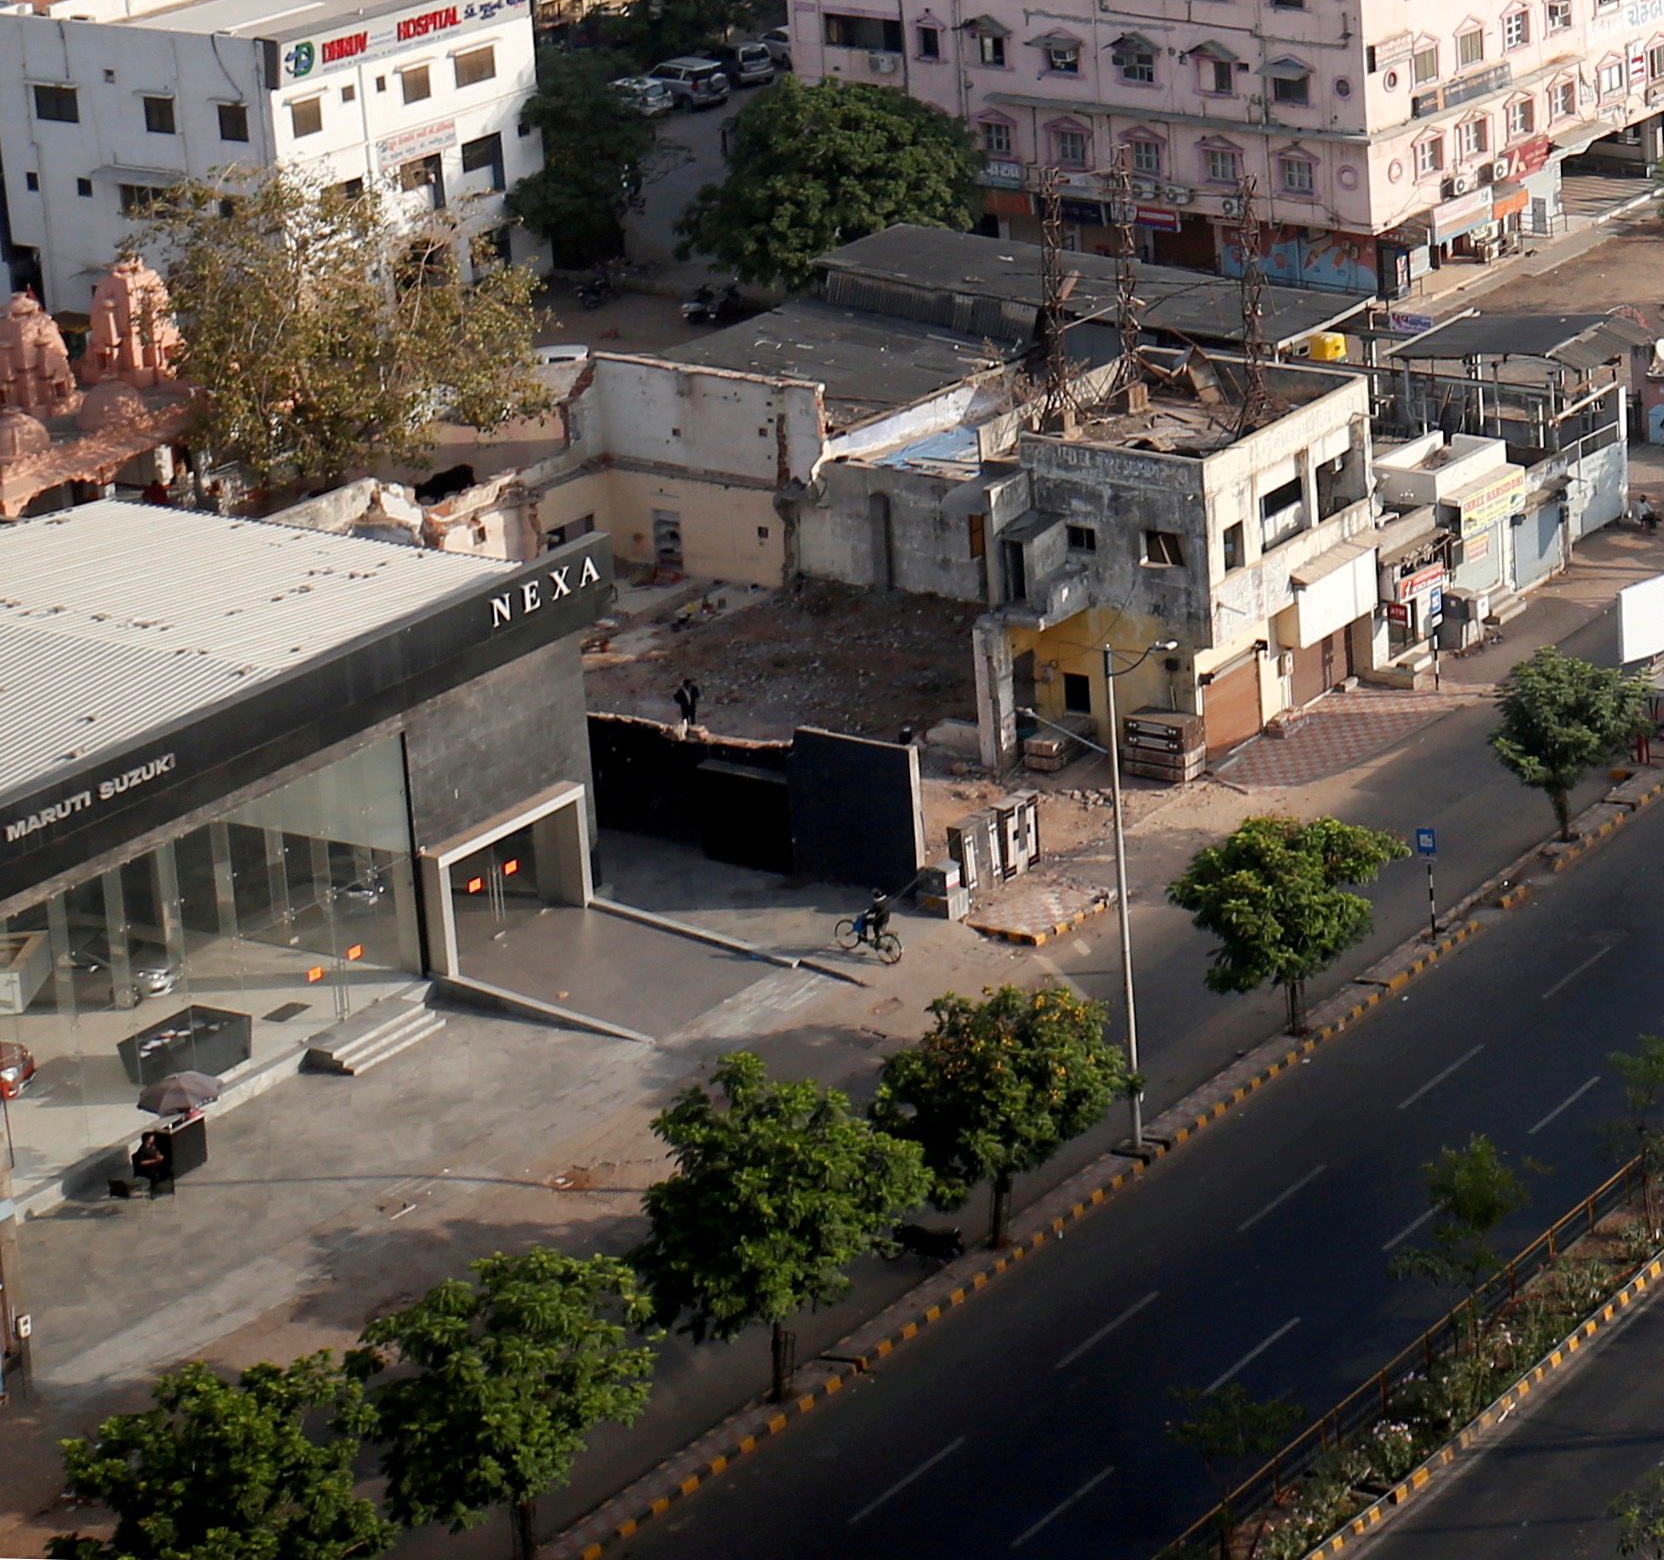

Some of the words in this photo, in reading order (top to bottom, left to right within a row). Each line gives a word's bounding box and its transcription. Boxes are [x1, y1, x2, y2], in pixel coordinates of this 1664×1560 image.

[322, 31, 368, 64] DHRUV
[397, 6, 462, 43] HOSPITAL
[489, 556, 601, 629] NEXA
[1390, 608, 1406, 616] ATM
[5, 791, 92, 842] MARUTI
[99, 753, 176, 801] SUZUKI
